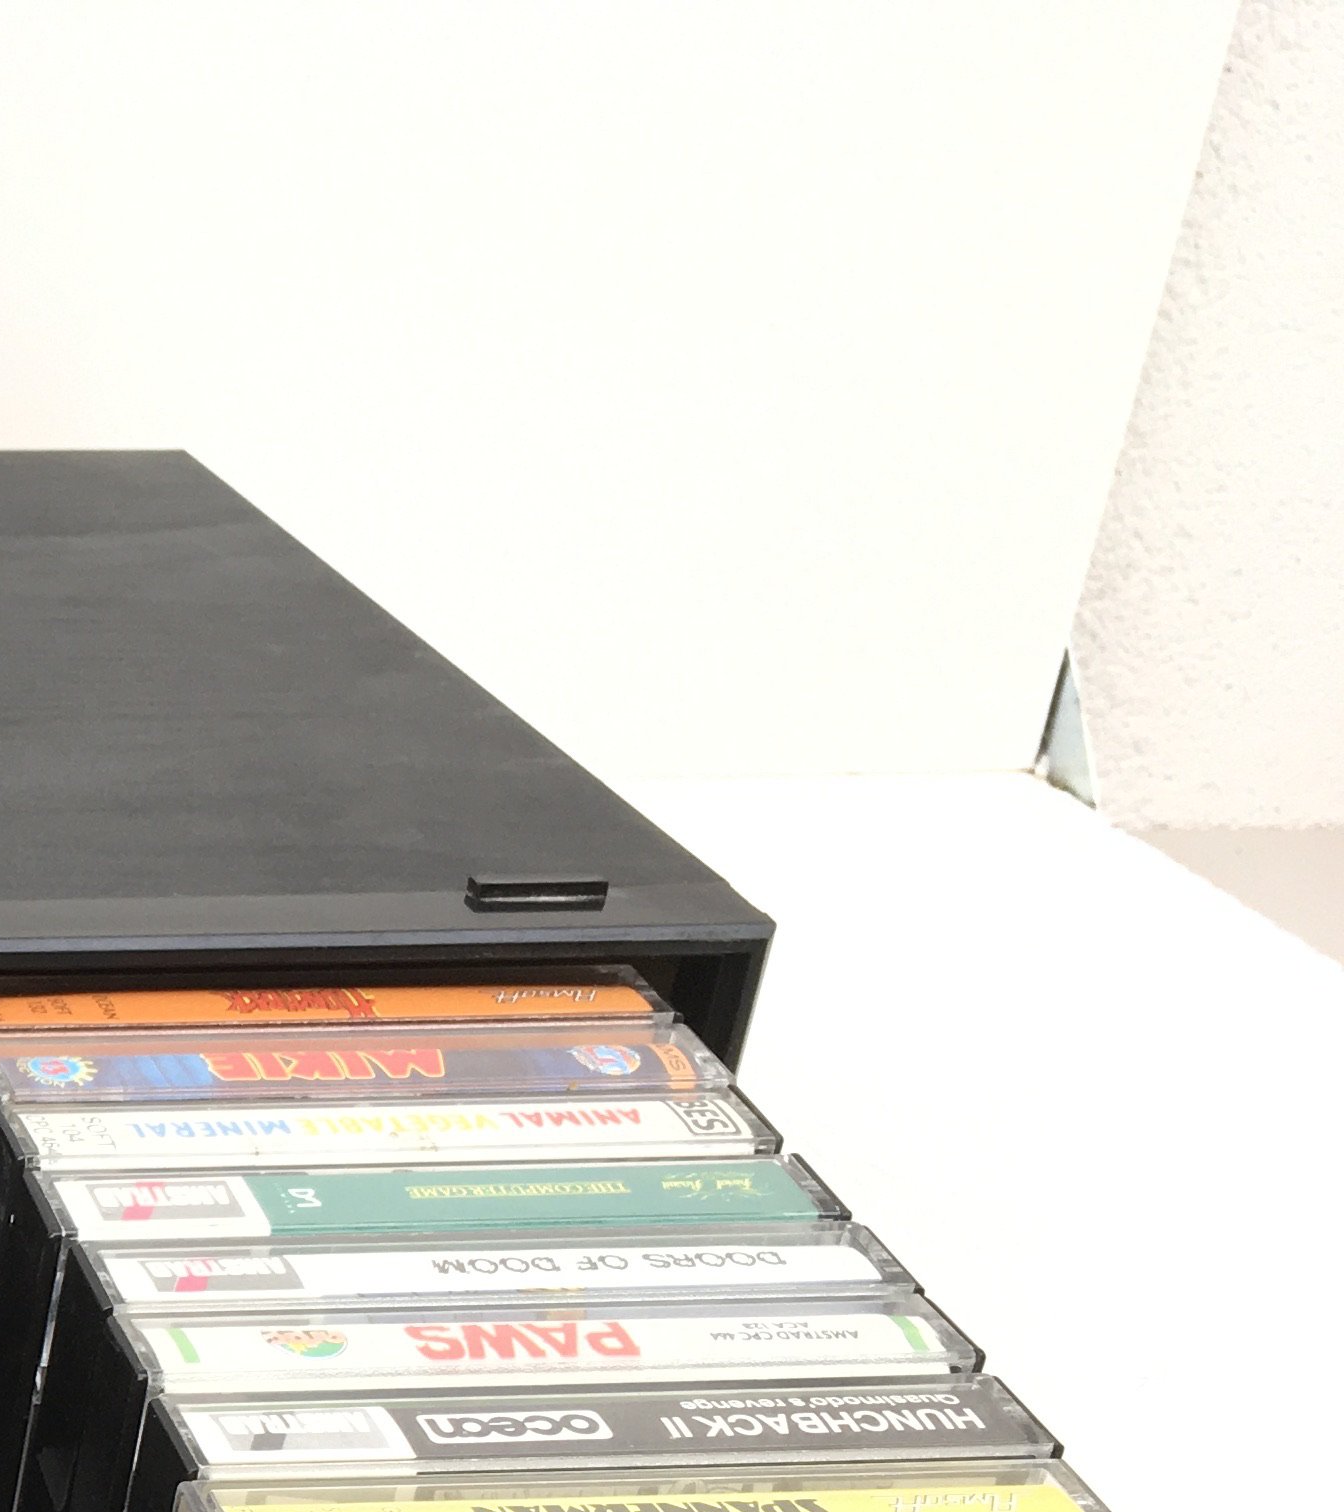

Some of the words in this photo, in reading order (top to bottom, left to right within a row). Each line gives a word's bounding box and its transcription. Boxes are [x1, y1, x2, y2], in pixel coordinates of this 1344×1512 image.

[126, 1118, 291, 1138] MINERAL
[498, 1108, 642, 1128] ANIMAL
[673, 1102, 729, 1134] BES
[432, 1256, 560, 1273] DOOM
[574, 1253, 627, 1270] OF
[644, 1250, 788, 1268] DOORS
[404, 1322, 642, 1361] PAWS
[681, 1396, 785, 1412] revenge
[788, 1392, 960, 1407] Quasimodo's
[430, 1414, 600, 1438] ocean
[660, 1416, 688, 1438] II
[693, 1407, 985, 1436] HUNCHBACK
